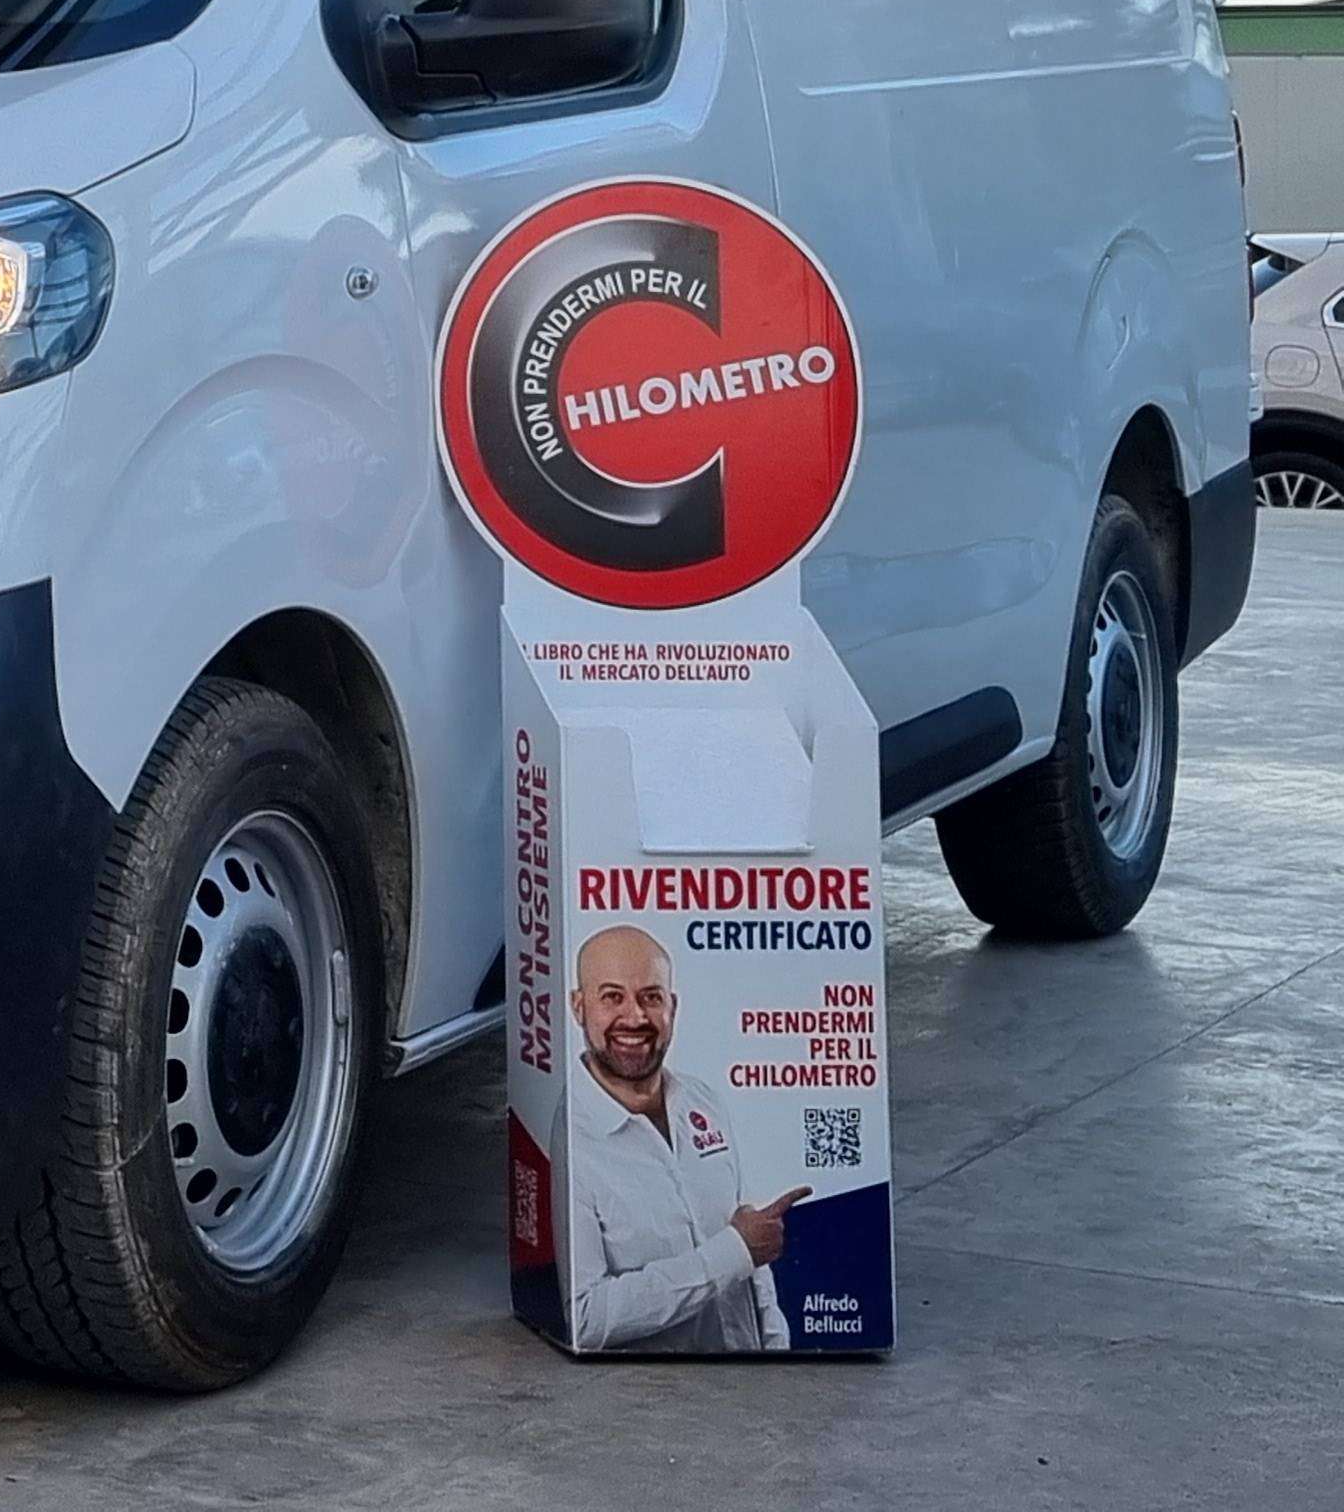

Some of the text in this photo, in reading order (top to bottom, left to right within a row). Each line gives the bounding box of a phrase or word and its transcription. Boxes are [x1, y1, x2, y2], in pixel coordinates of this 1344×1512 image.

[523, 268, 707, 462] NON PRENDERMI PER IL
[534, 643, 583, 660] LIBRO
[587, 643, 620, 660] CHE
[624, 643, 648, 660] HA
[656, 643, 790, 661] RIVOLUZIONATO
[560, 664, 751, 681] IL MERCATO DELL'AUTO
[516, 728, 535, 1067] NON CONTRO
[579, 867, 871, 911] RIVENDITORE
[532, 764, 552, 1075] MA INSIEME
[686, 920, 873, 951] CERTIFICATO
[824, 984, 874, 1007] NON
[741, 1011, 875, 1034] PRENDERMI
[810, 1038, 878, 1060] PER IL
[729, 1064, 877, 1088] CHILOMETRO
[802, 1292, 859, 1312] Alfredo
[804, 1314, 863, 1334] Bellucci
